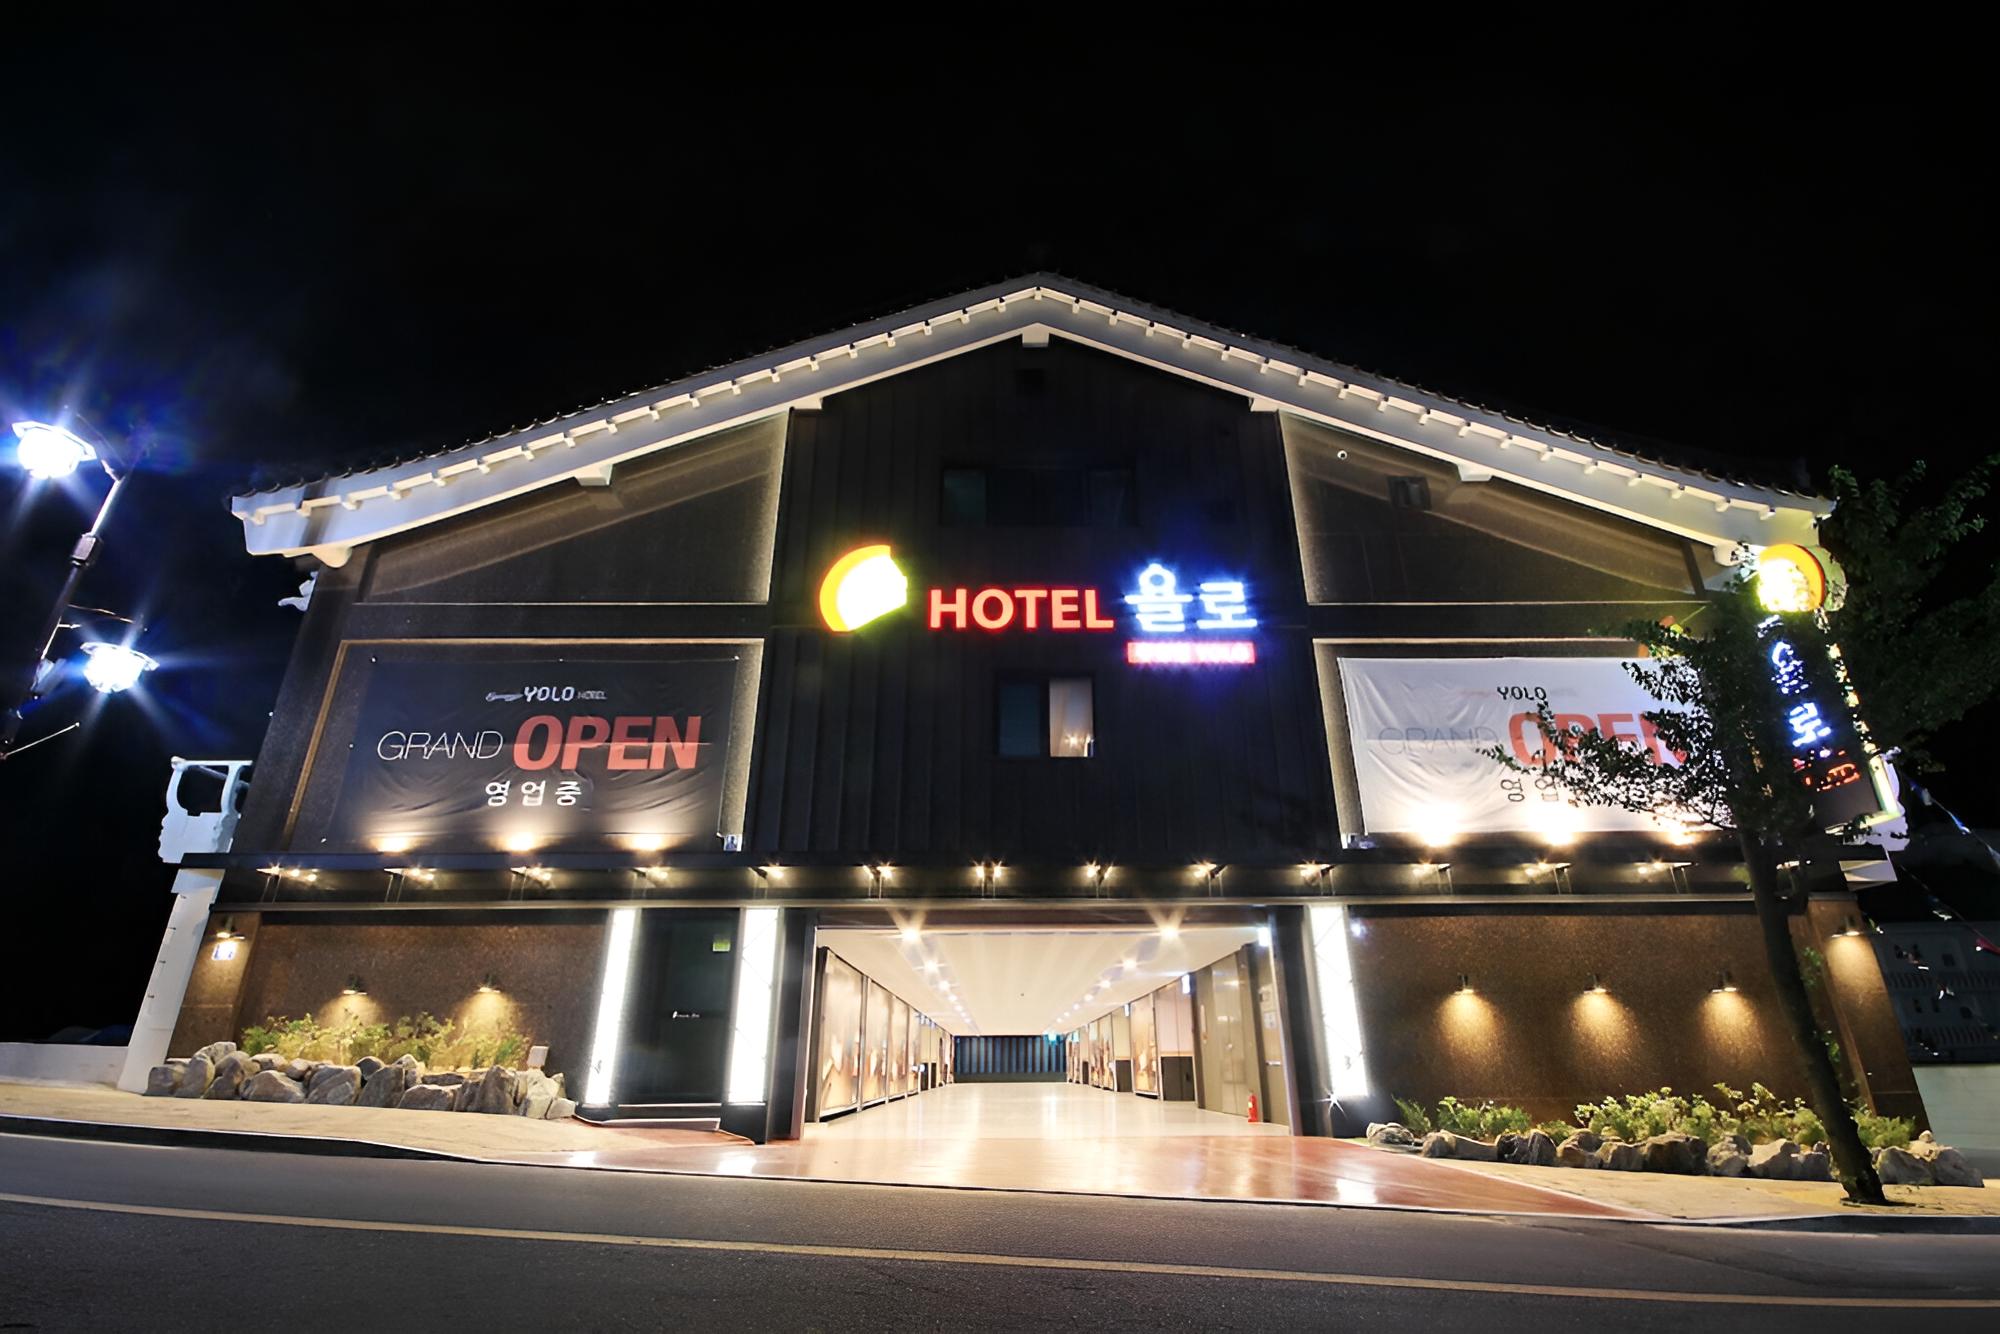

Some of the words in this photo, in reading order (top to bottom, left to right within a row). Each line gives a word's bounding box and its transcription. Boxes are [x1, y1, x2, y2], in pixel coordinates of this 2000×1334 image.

[929, 587, 1115, 630] HOTEL
[1123, 562, 1258, 633] 욜로
[524, 685, 575, 702] YOLO
[1497, 686, 1547, 701] YOLO
[377, 730, 504, 761] GRAND
[513, 714, 702, 771] OPEN
